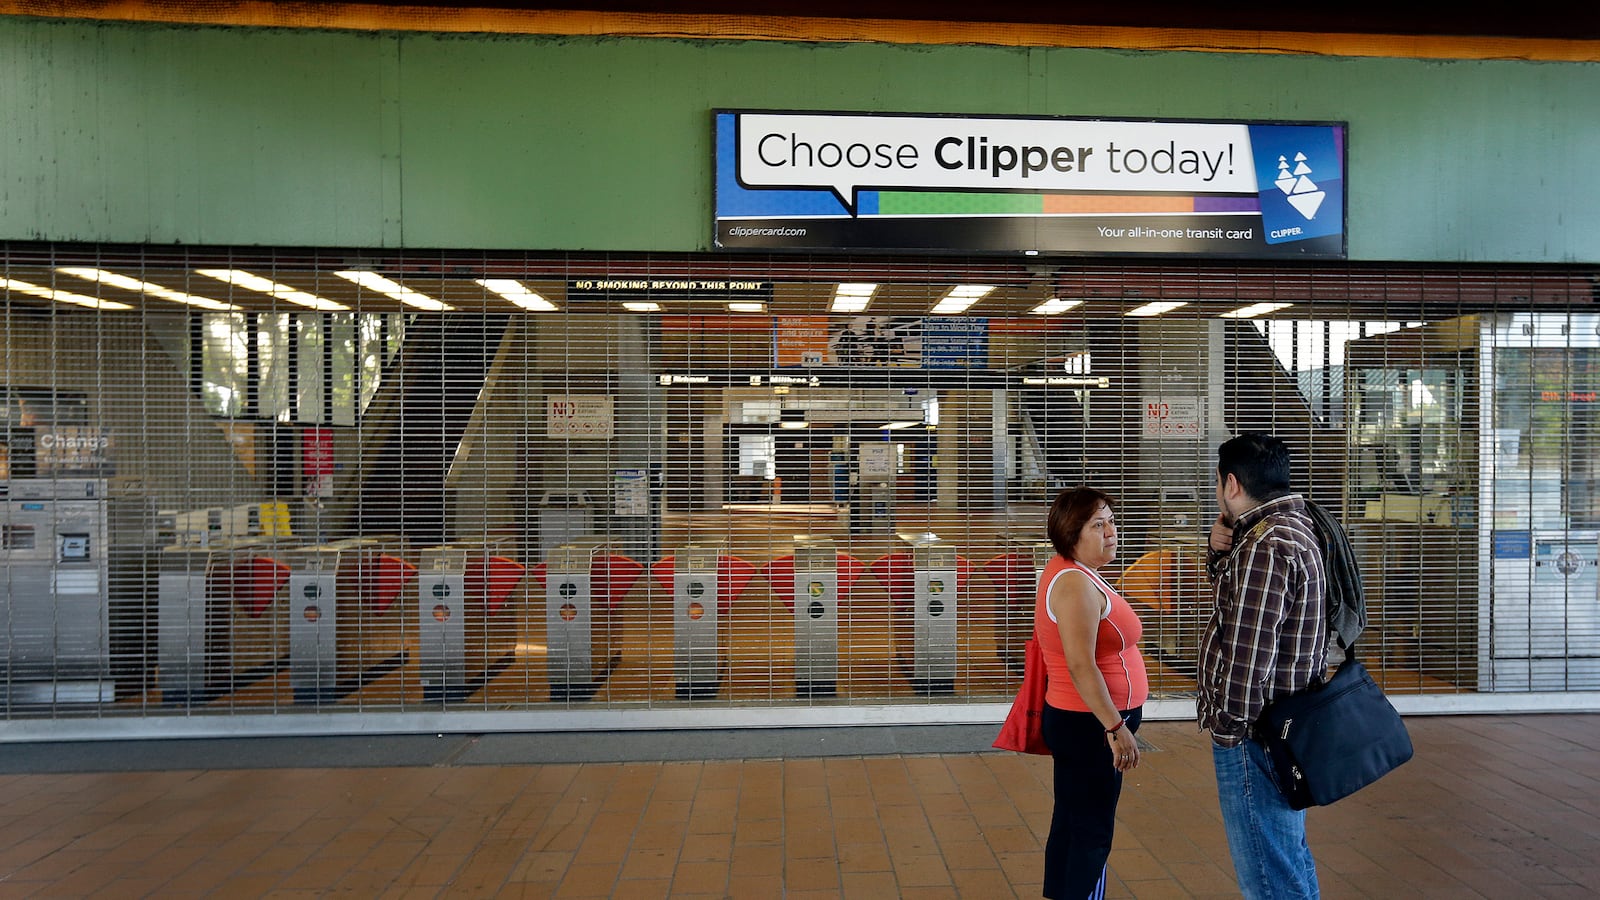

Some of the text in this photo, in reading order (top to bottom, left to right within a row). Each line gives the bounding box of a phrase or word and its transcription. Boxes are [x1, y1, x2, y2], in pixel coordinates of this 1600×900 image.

[757, 132, 1235, 182] Choose Clipper today!
[728, 226, 807, 237] clippercard.com
[1097, 226, 1253, 240] Your all-in-one transit card
[575, 280, 763, 290] NO SMOKING BEYOND THIS POINT
[553, 402, 576, 418] NO
[1148, 403, 1169, 419] NO
